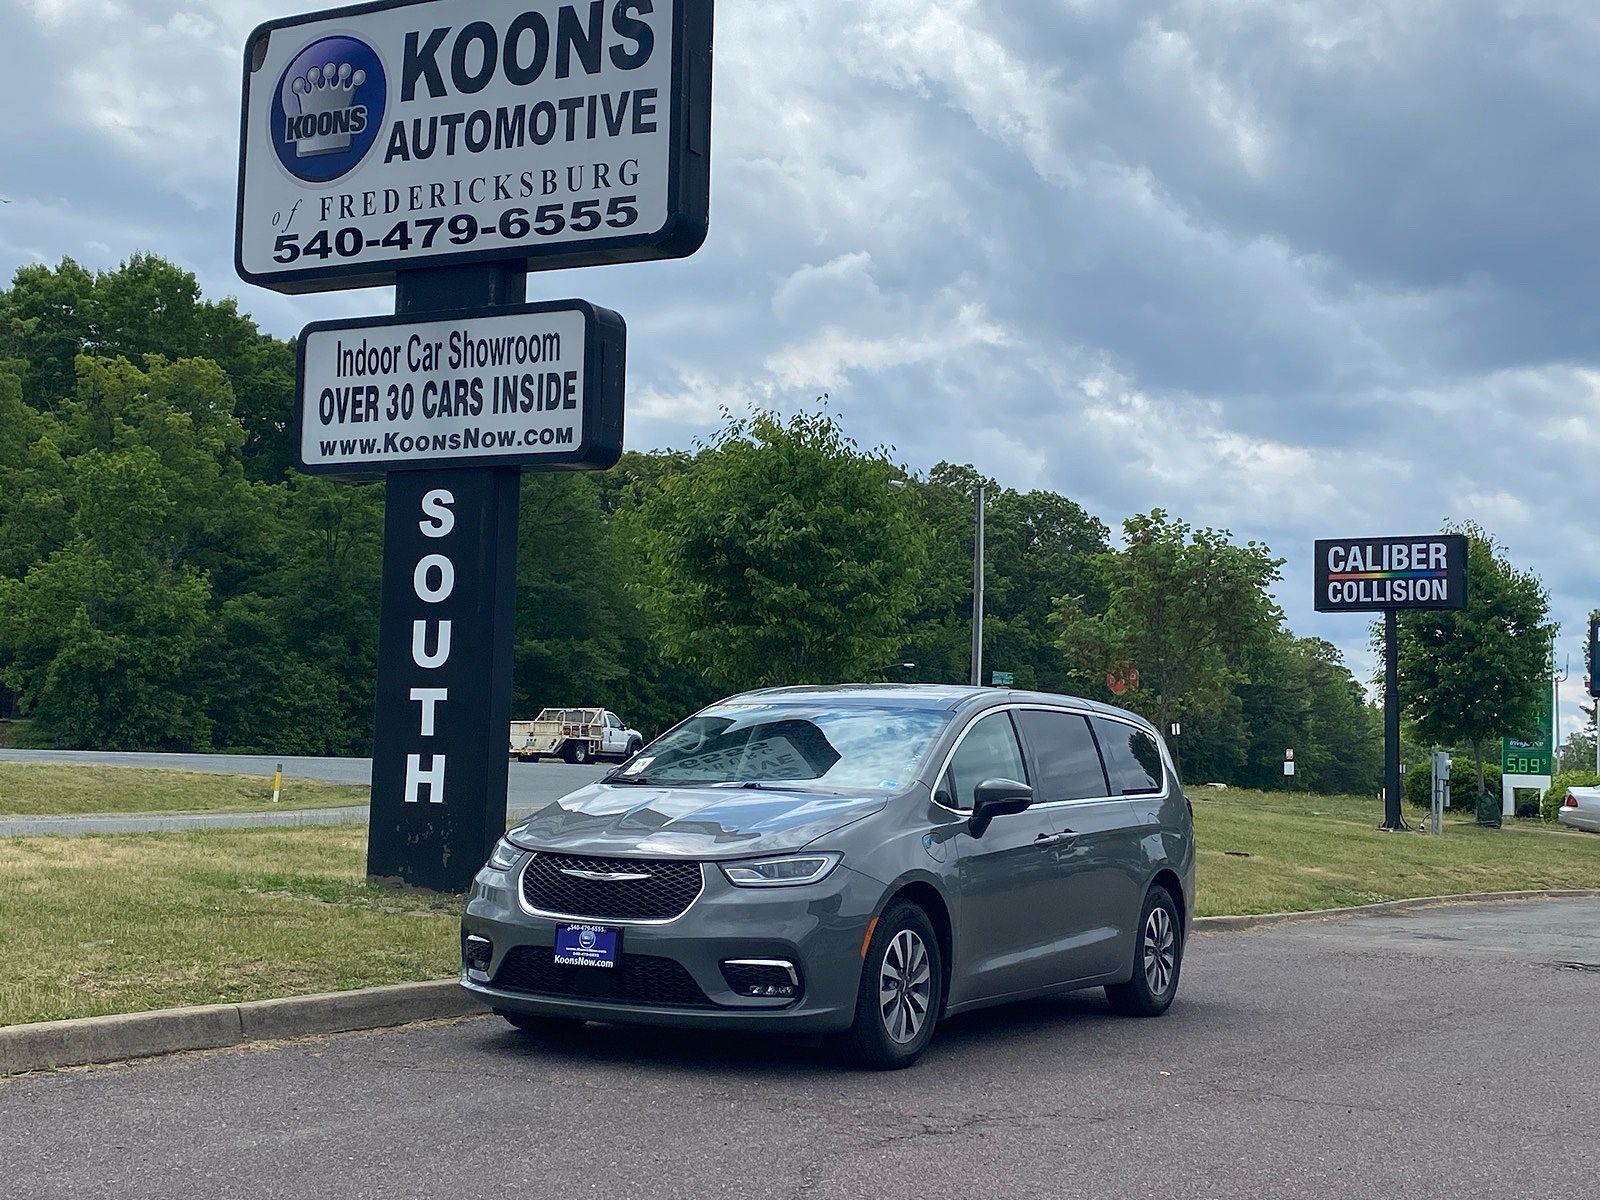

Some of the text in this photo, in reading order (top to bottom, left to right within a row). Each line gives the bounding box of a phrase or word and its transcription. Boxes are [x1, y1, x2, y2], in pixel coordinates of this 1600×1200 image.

[400, 0, 654, 102] KOONS
[286, 106, 367, 141] KOONS
[384, 88, 657, 164] AUTOMOTIVE
[272, 159, 640, 233] of FREDERICKSBURG
[272, 195, 638, 263] 540-479-6555
[337, 330, 560, 377] Indoor Car Showroom
[319, 371, 577, 425] OVER 30 CARS INSIDE
[1328, 543, 1447, 573] CALIBER
[1328, 579, 1447, 602] COLLISION
[404, 489, 455, 803] SOUTH
[554, 955, 613, 968] KoonsNow.com
